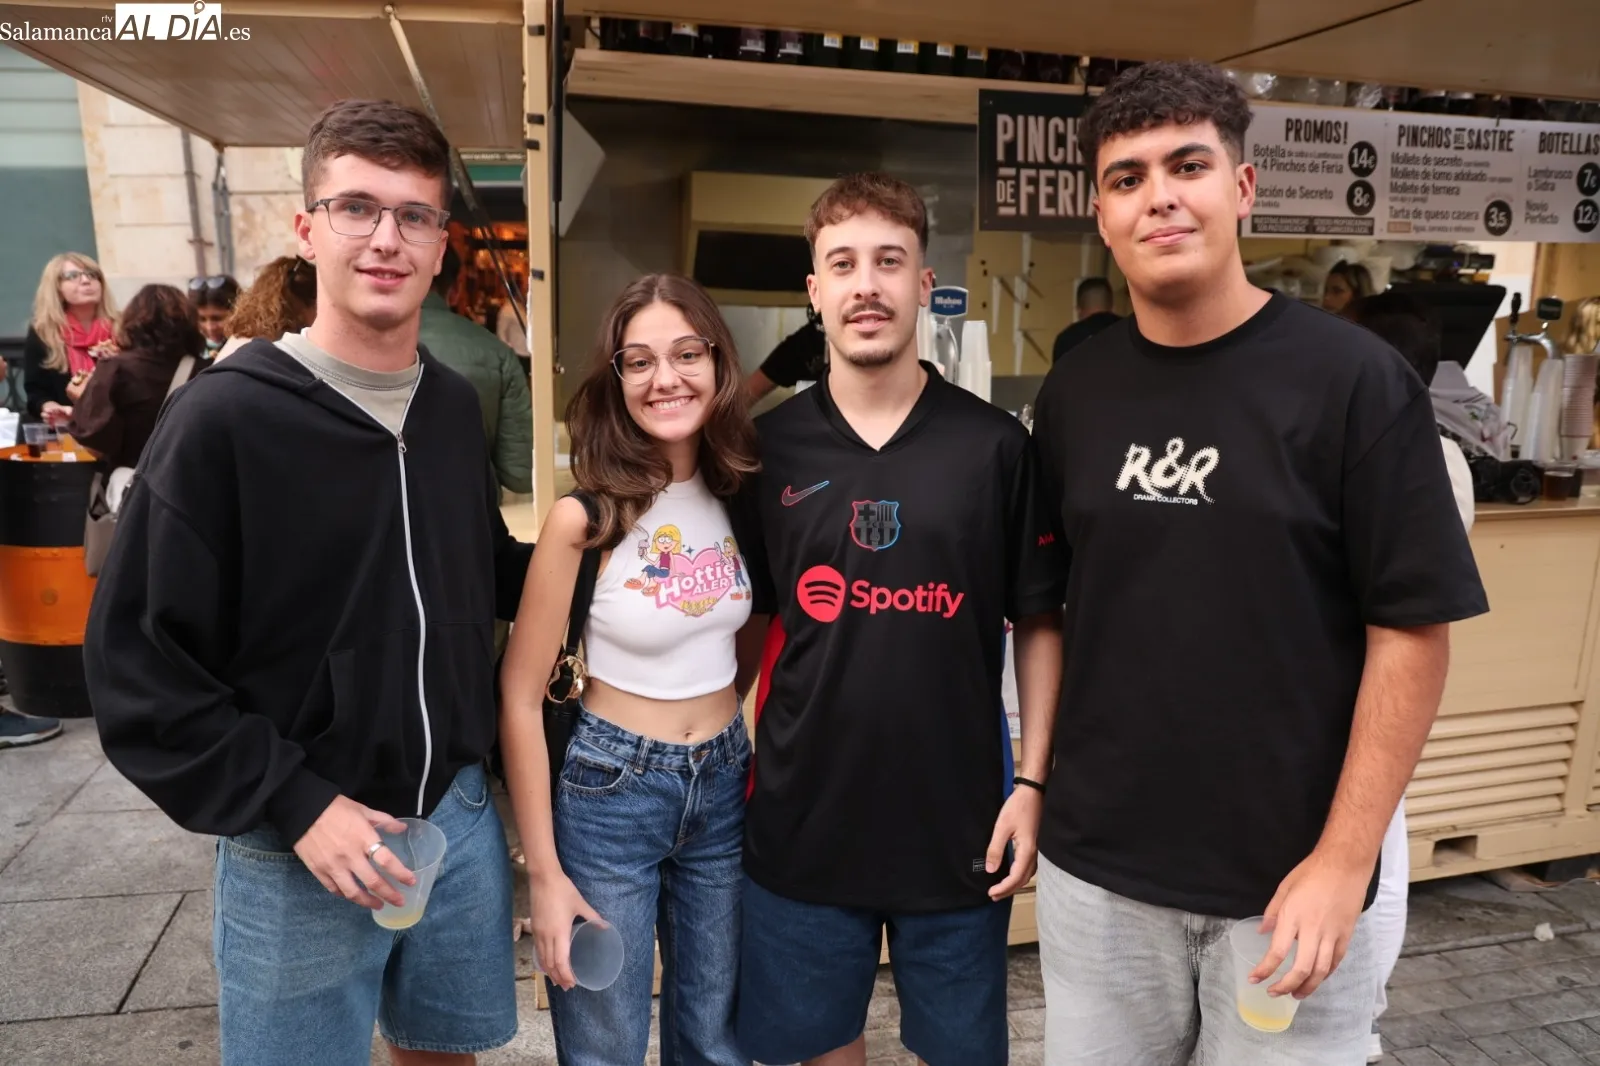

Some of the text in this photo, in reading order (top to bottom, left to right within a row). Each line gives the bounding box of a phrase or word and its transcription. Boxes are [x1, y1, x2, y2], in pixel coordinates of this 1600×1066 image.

[996, 113, 1084, 164] PINCH
[1285, 117, 1348, 145] PROMOS!
[1397, 124, 1452, 149] PINCHOS
[1467, 128, 1515, 152] SASTRE
[1253, 143, 1286, 158] Botella
[1538, 131, 1600, 155] BOTELLAS
[1261, 158, 1268, 171] 4
[1270, 158, 1306, 172] Pinchos
[1308, 160, 1320, 173] de
[1321, 160, 1344, 174] Feria
[1351, 147, 1375, 168] 14€
[1422, 153, 1432, 166] de
[1528, 165, 1573, 180] Lambrusco
[996, 179, 1016, 203] DE
[1285, 186, 1297, 199] de
[1299, 186, 1334, 200] Secreto
[1353, 187, 1370, 208] 8€
[1115, 437, 1220, 504] R&R
[657, 561, 735, 605] Hottie
[692, 576, 734, 596] ALERT
[850, 580, 964, 618] Spotify
